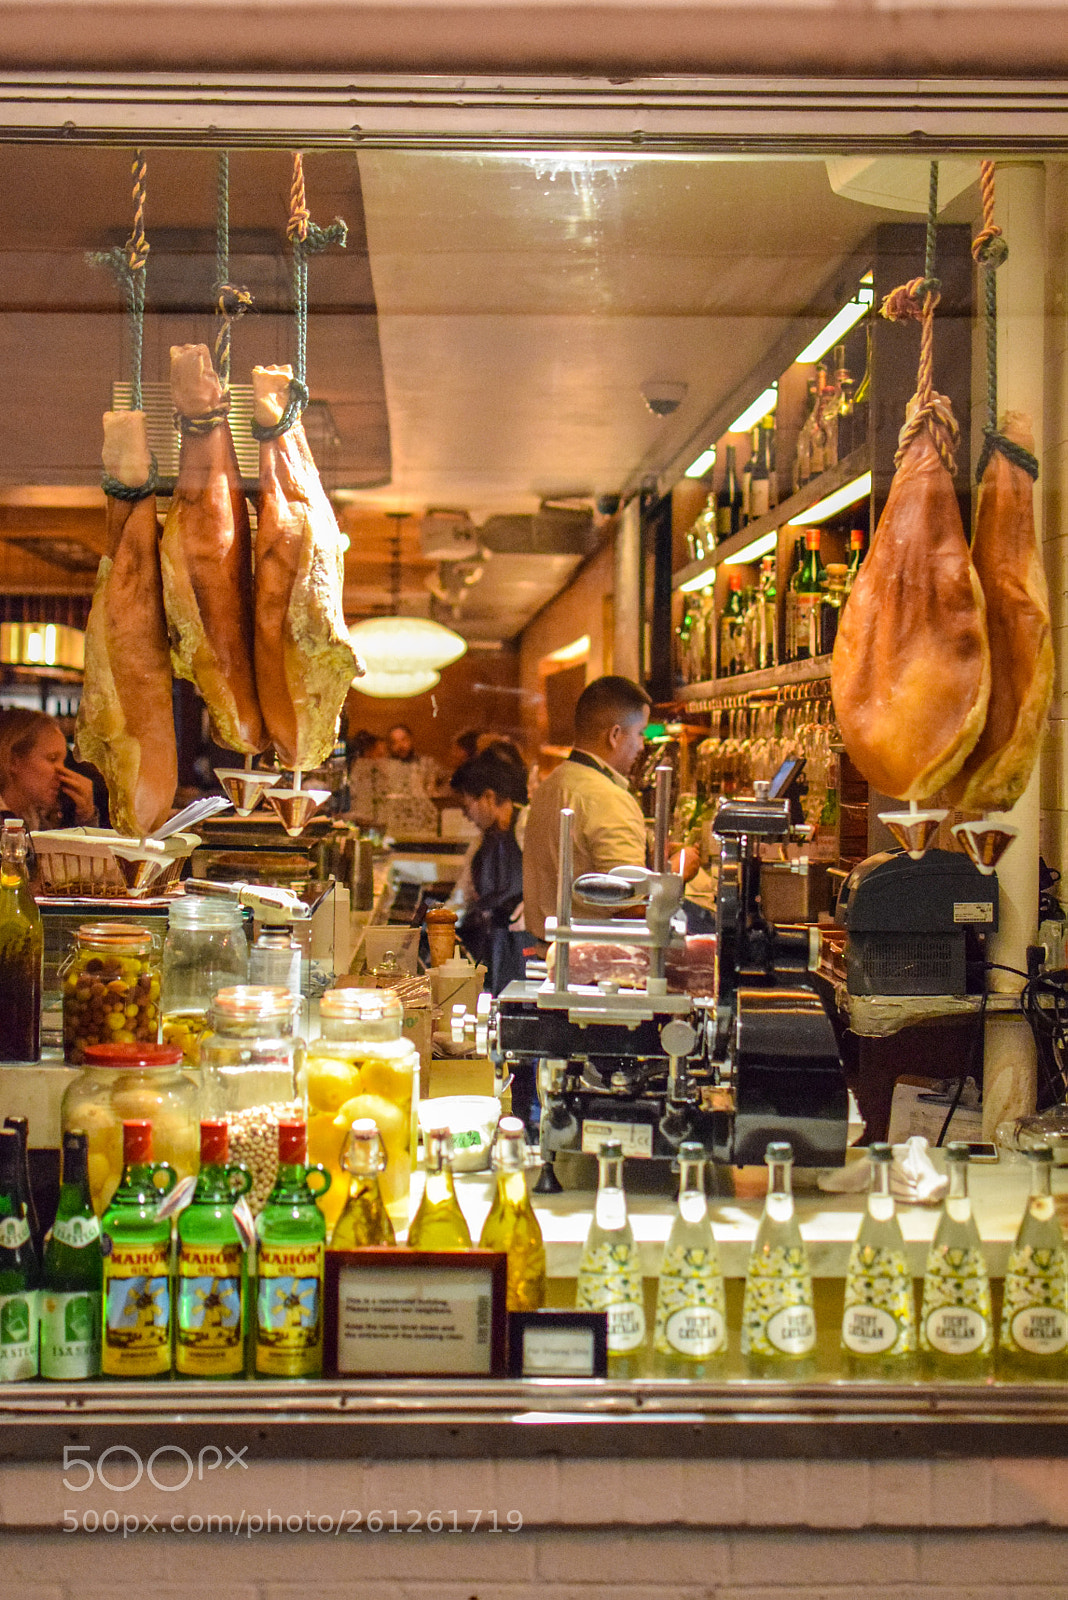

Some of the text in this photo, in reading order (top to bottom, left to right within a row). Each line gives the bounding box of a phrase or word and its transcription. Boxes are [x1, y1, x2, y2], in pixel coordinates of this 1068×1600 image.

[130, 1266, 149, 1274] GIN
[197, 1266, 217, 1274] GIN
[278, 1266, 297, 1274] GIN
